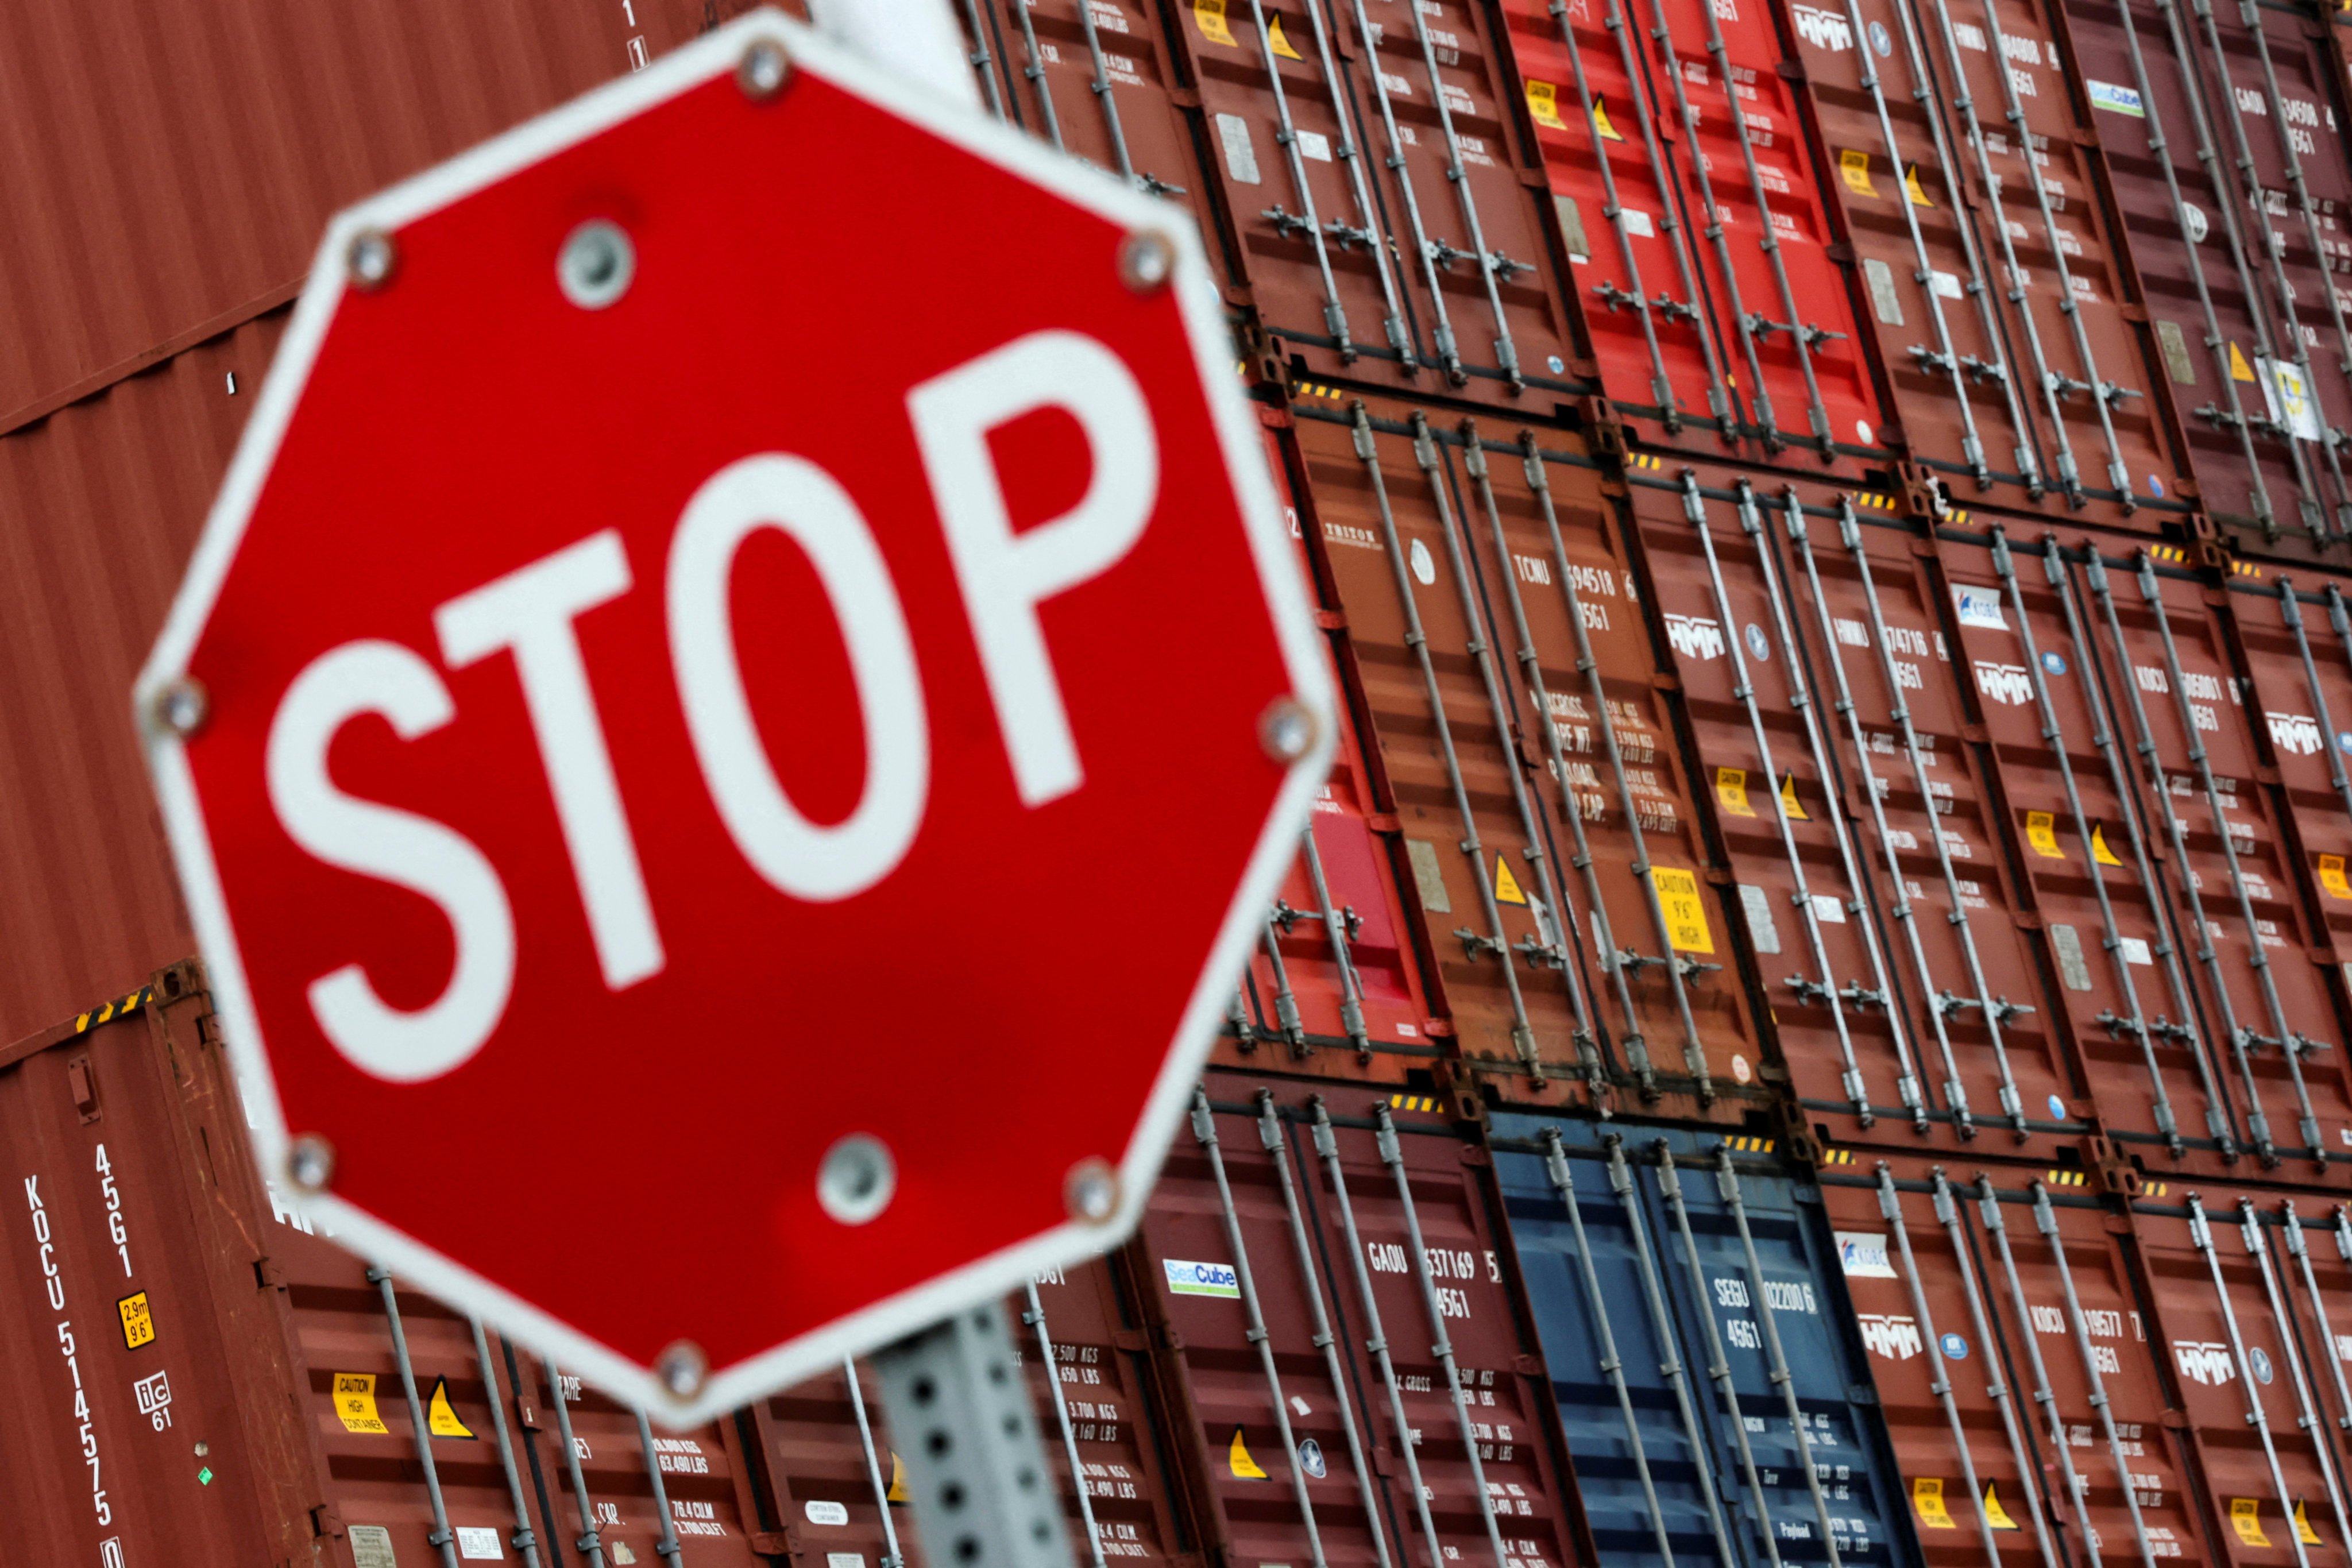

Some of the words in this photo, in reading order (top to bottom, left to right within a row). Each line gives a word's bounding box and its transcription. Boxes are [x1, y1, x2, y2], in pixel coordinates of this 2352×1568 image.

[1794, 12, 1853, 51] HMM
[1285, 507, 1301, 537] 2
[1324, 522, 1375, 542] TRITON
[1514, 554, 1550, 585] TCNU
[1624, 573, 1636, 600] 6
[1666, 620, 1725, 661] HMM
[1885, 626, 1928, 656] 74716
[1897, 661, 1922, 689] 5G1
[1976, 668, 2034, 706] HMM
[265, 329, 1160, 1084] STOP
[2268, 719, 2323, 755] HMM
[1655, 874, 1696, 894] CAUTION
[1678, 925, 1702, 944] HIGH
[96, 1144, 132, 1277] 45G1
[1167, 1262, 1235, 1285] SeaCube
[1368, 1242, 1408, 1273] GAOU
[1485, 1252, 1501, 1283] 5
[1714, 1278, 1749, 1308] SEGU
[1763, 1281, 1805, 1311] 02200
[1802, 1284, 1817, 1313] 6
[124, 1301, 148, 1323] 2,9m
[2030, 1306, 2065, 1334] KOCU
[2129, 1311, 2145, 1341] 7
[130, 1318, 148, 1342] 9'6"
[1727, 1319, 1762, 1349] 45G1
[1860, 1322, 1922, 1360] HMM
[25, 1175, 64, 1310] KOCU
[57, 1322, 111, 1527] 514575
[1052, 1345, 1076, 1361] 2.500
[1081, 1347, 1098, 1364] KGS
[1081, 1367, 1100, 1385] LBS
[2176, 1348, 2236, 1386] HMM
[141, 1385, 167, 1407] ic
[340, 1378, 369, 1393] CAUTION
[347, 1399, 364, 1412] HIGH
[1480, 1391, 1495, 1406] LBS
[152, 1407, 171, 1432] 61
[1068, 1401, 1095, 1419] 3.700
[1098, 1403, 1118, 1420] KGS
[343, 1418, 385, 1430] CONTAINER
[1100, 1424, 1117, 1442] LBS
[682, 1440, 702, 1454] KGS
[1499, 1445, 1513, 1461] LBS
[659, 1455, 689, 1472] 63.490
[690, 1457, 708, 1473] LBS
[1107, 1464, 1130, 1478] KGS
[1117, 1482, 1137, 1499] LBS
[671, 1501, 692, 1518] 76.4
